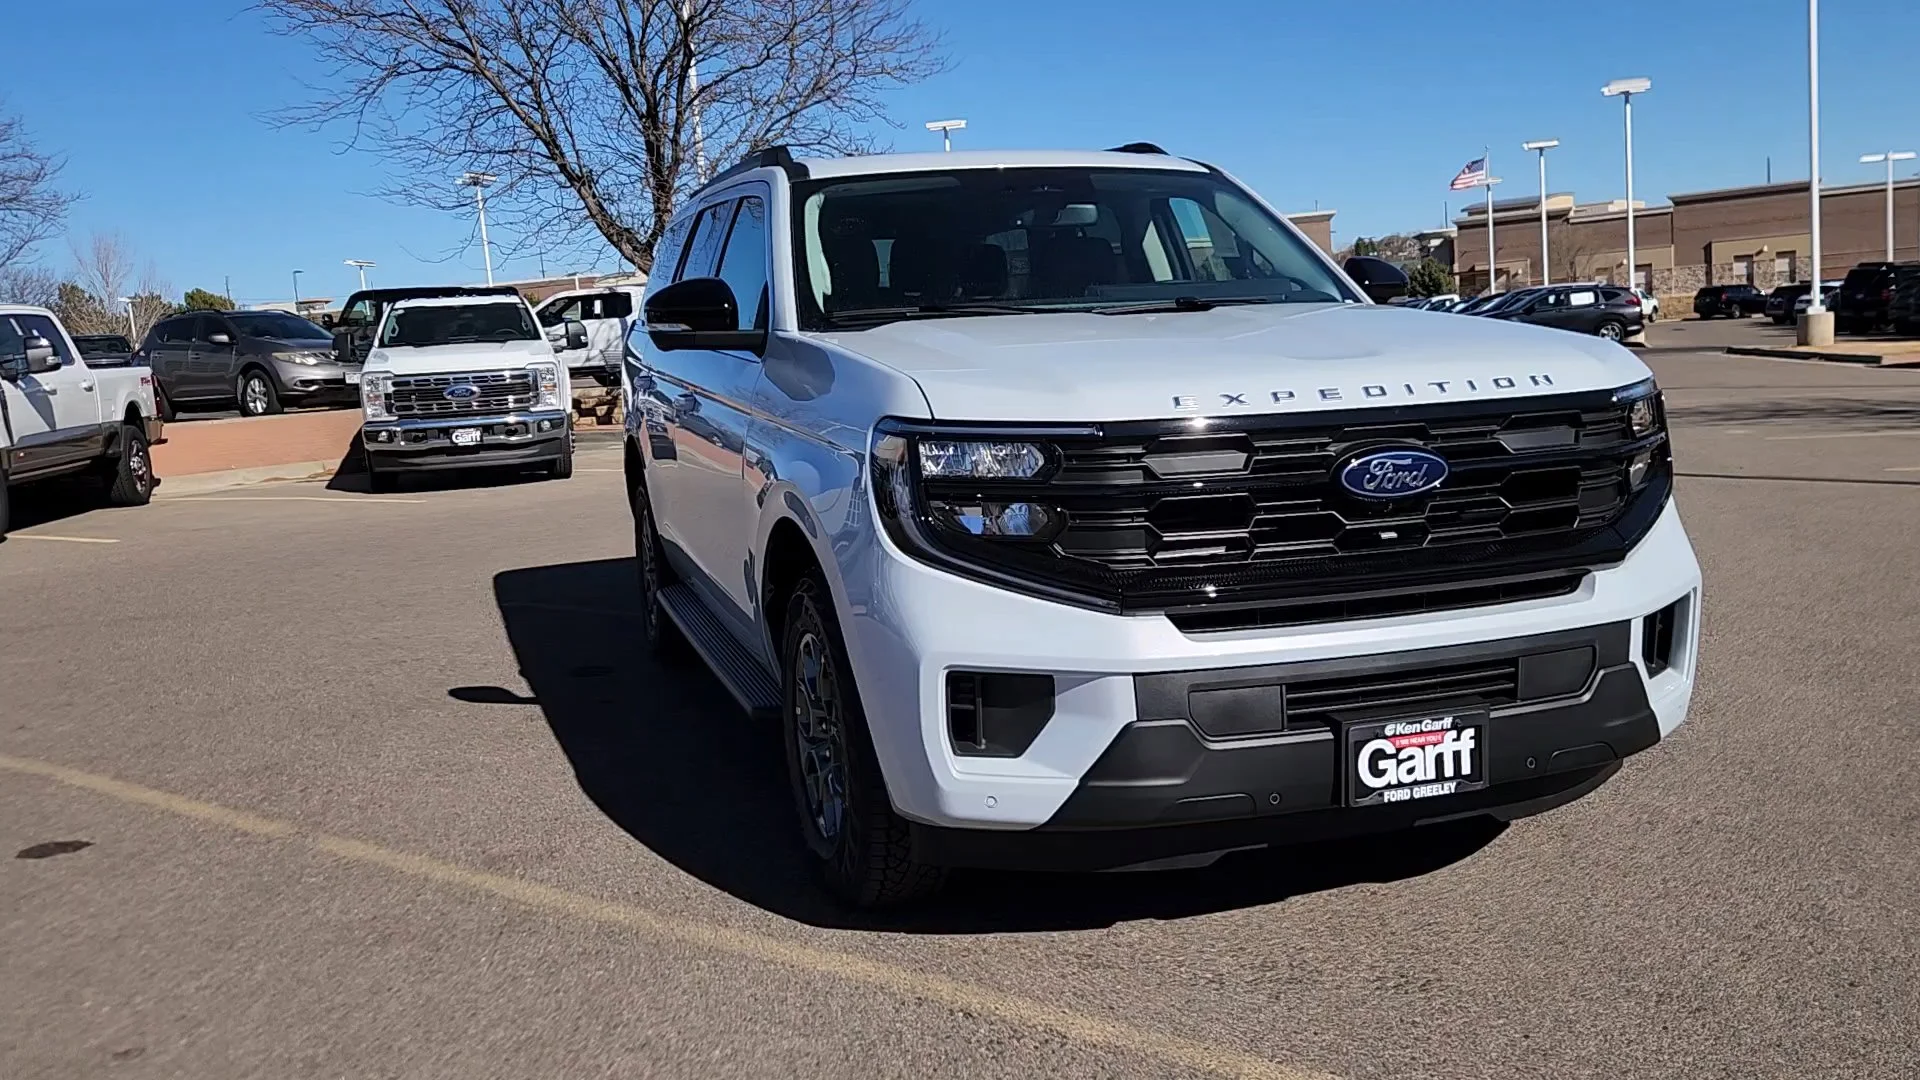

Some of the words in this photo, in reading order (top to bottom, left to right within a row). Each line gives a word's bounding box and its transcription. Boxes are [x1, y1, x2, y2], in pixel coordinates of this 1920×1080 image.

[1172, 374, 1554, 410] EXPEDITION
[452, 430, 481, 443] Garff
[1363, 458, 1428, 490] Ford
[1396, 722, 1421, 735] Ken
[1421, 716, 1453, 731] Garff
[1358, 728, 1475, 788] Garff
[1384, 788, 1411, 803] FORD
[1413, 781, 1457, 799] GREELEY
